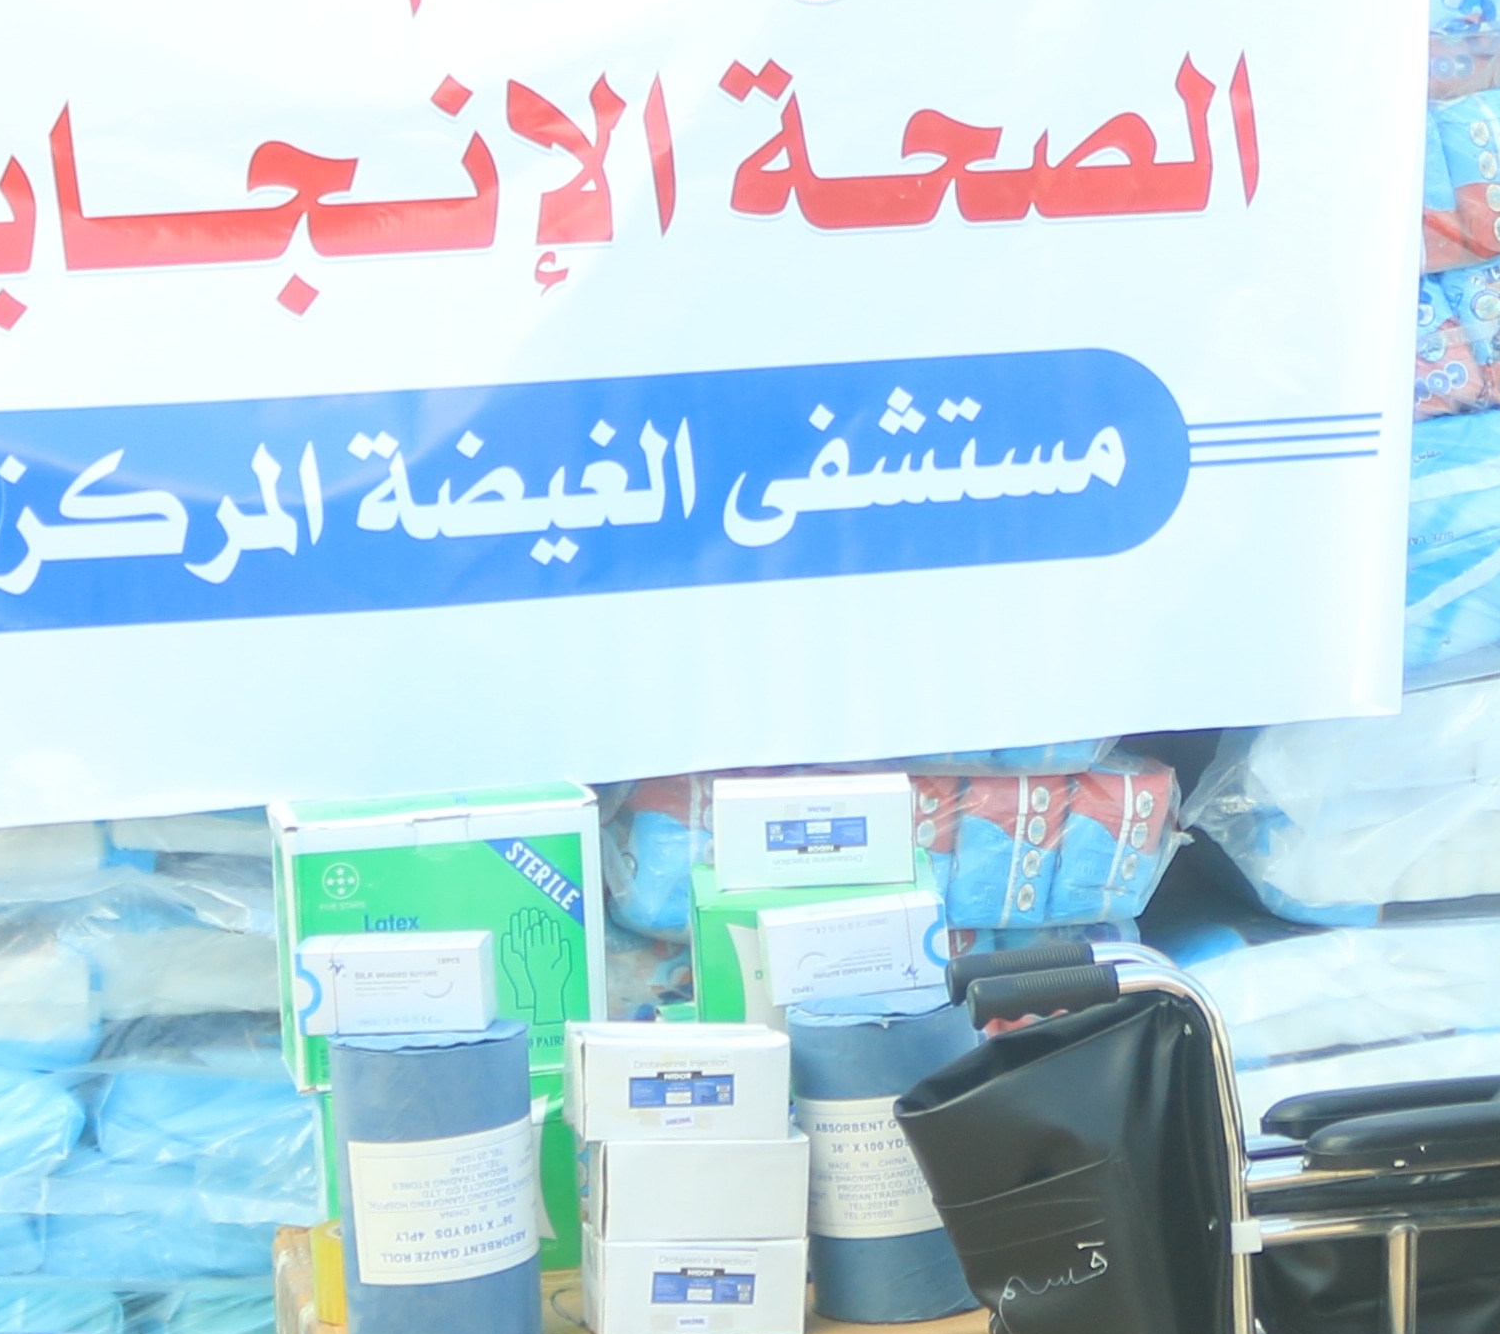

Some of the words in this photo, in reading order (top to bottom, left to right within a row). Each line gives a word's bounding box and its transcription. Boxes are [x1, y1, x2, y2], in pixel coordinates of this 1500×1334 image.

[717, 49, 1260, 231] الصحة
[722, 386, 1126, 548] مستشفى
[346, 416, 697, 566] الغيضة
[505, 841, 581, 911] STERILE
[363, 913, 420, 933] Latex
[815, 1120, 884, 1134] ABSORBENT
[864, 1141, 885, 1153] 100
[394, 1230, 425, 1243] 4PLY
[434, 1227, 461, 1240] YDS
[463, 1222, 483, 1237] 100
[462, 1229, 527, 1257] ABSORBENT
[380, 1252, 411, 1264] ROLL
[415, 1248, 459, 1263] GAUZE
